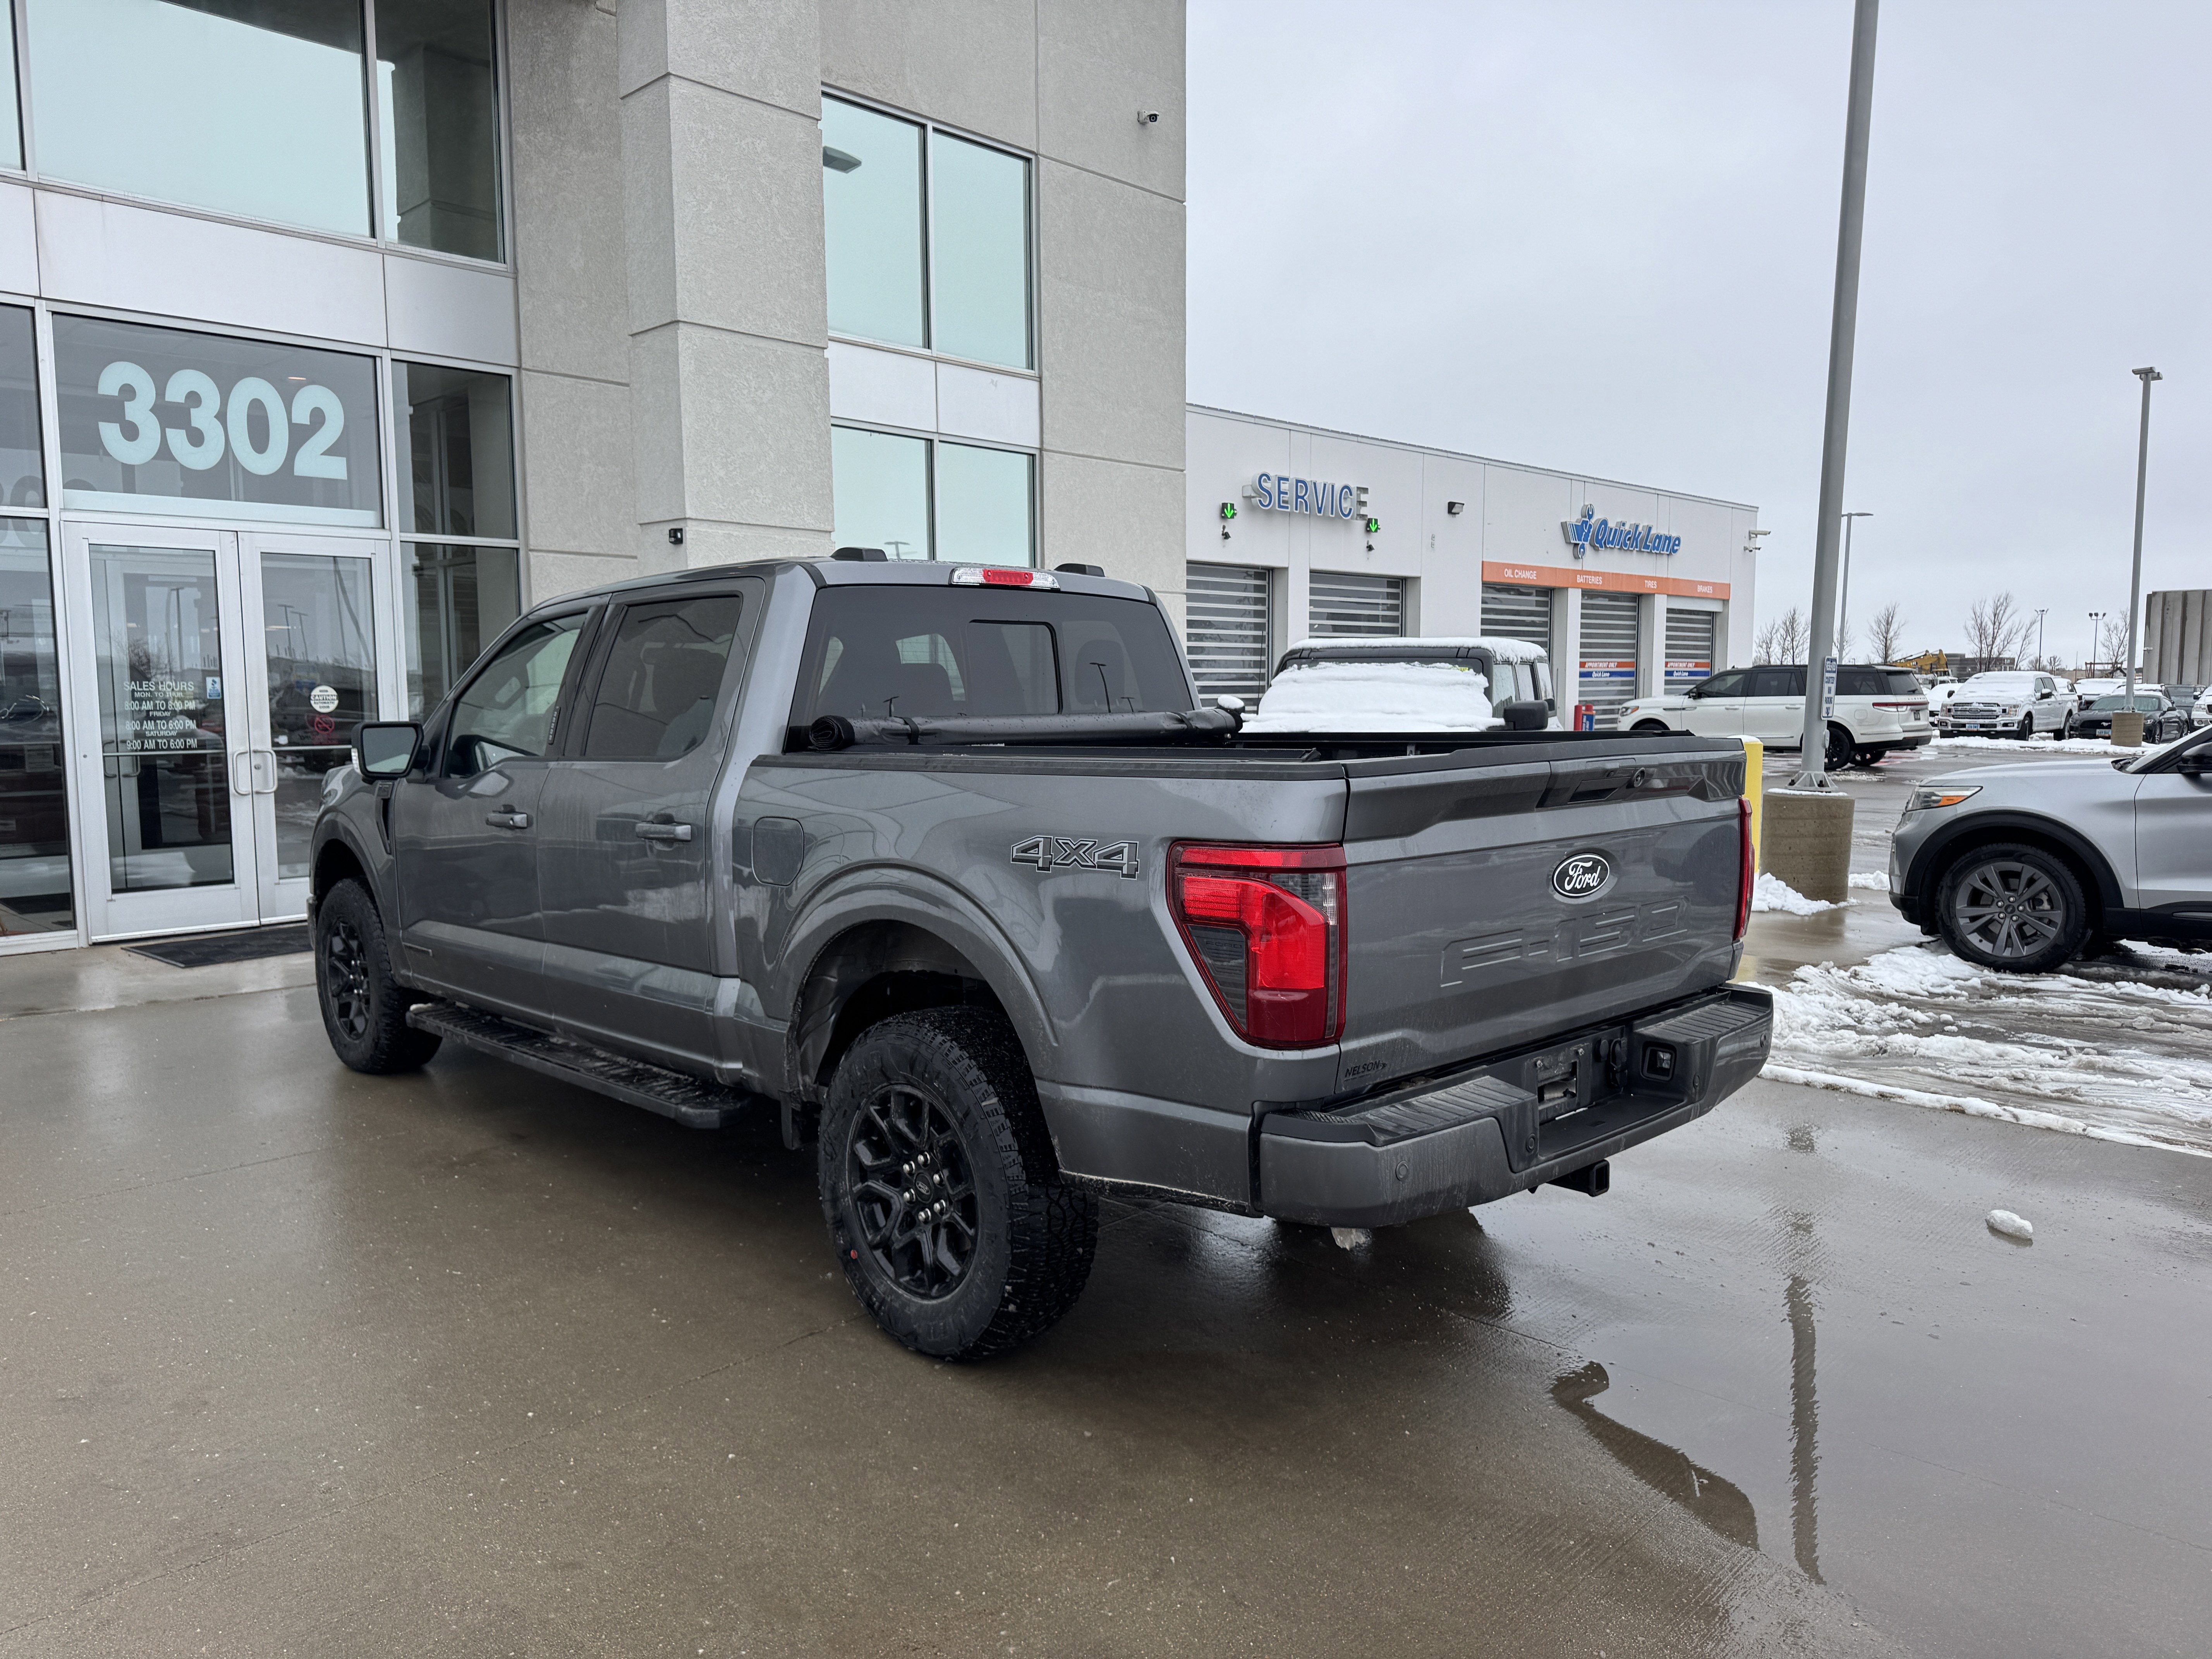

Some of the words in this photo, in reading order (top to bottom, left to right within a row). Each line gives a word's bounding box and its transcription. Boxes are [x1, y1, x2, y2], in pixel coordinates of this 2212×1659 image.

[98, 361, 347, 480] 3302
[1252, 471, 1369, 520] SERVICE
[1592, 517, 1643, 551] Quick
[1641, 524, 1681, 555] Lane
[1504, 568, 1513, 578] OIL
[1515, 569, 1537, 580] CHANGE
[1577, 575, 1602, 585] BATTERIES
[1645, 580, 1657, 589] TIRES
[1697, 584, 1713, 594] BRAKES
[124, 681, 155, 691] SALES
[159, 681, 194, 691] HOURS
[124, 701, 139, 710] 8:00
[141, 700, 153, 710] AM
[155, 700, 166, 710] TO
[168, 701, 182, 710] 8:00
[184, 701, 196, 710] PM
[125, 720, 140, 730] 8:00
[143, 720, 155, 730] AM
[156, 720, 167, 730] TO
[168, 720, 183, 730] 6:00
[185, 720, 197, 729] PM
[126, 740, 141, 750] 9:00
[144, 739, 156, 749] AM
[157, 739, 168, 749] TO
[170, 739, 184, 749] 6:00
[186, 738, 198, 748] PM
[1010, 835, 1140, 881] 4X4
[1565, 861, 1601, 891] Ford
[1440, 895, 1690, 987] F-150
[1345, 1060, 1381, 1078] NELSON
